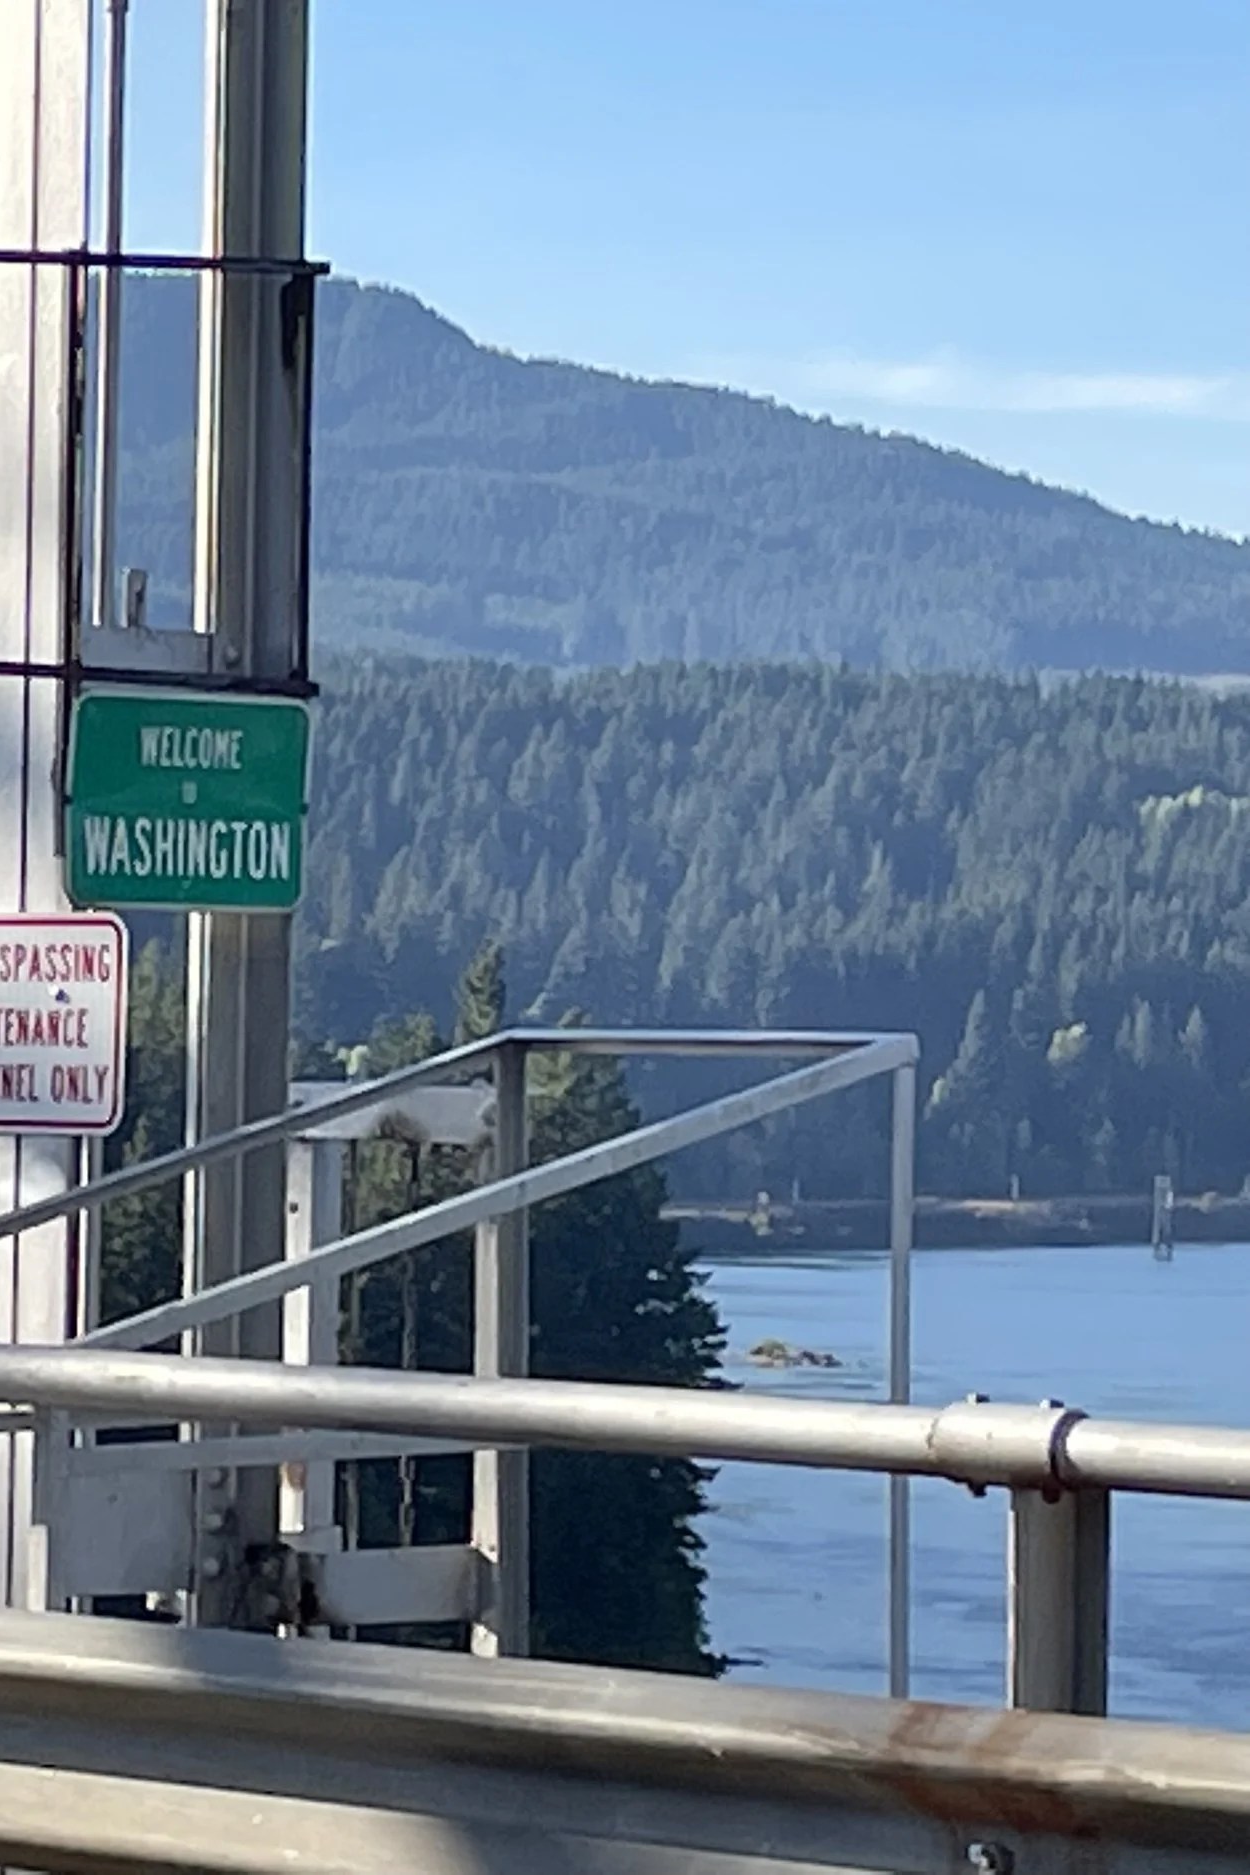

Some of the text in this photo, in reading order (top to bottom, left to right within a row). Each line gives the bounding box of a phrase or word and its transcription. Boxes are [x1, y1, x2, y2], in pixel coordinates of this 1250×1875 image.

[140, 726, 243, 769] WELCOME
[83, 816, 290, 880] WASHINGTON
[50, 1065, 109, 1104] ONLY
